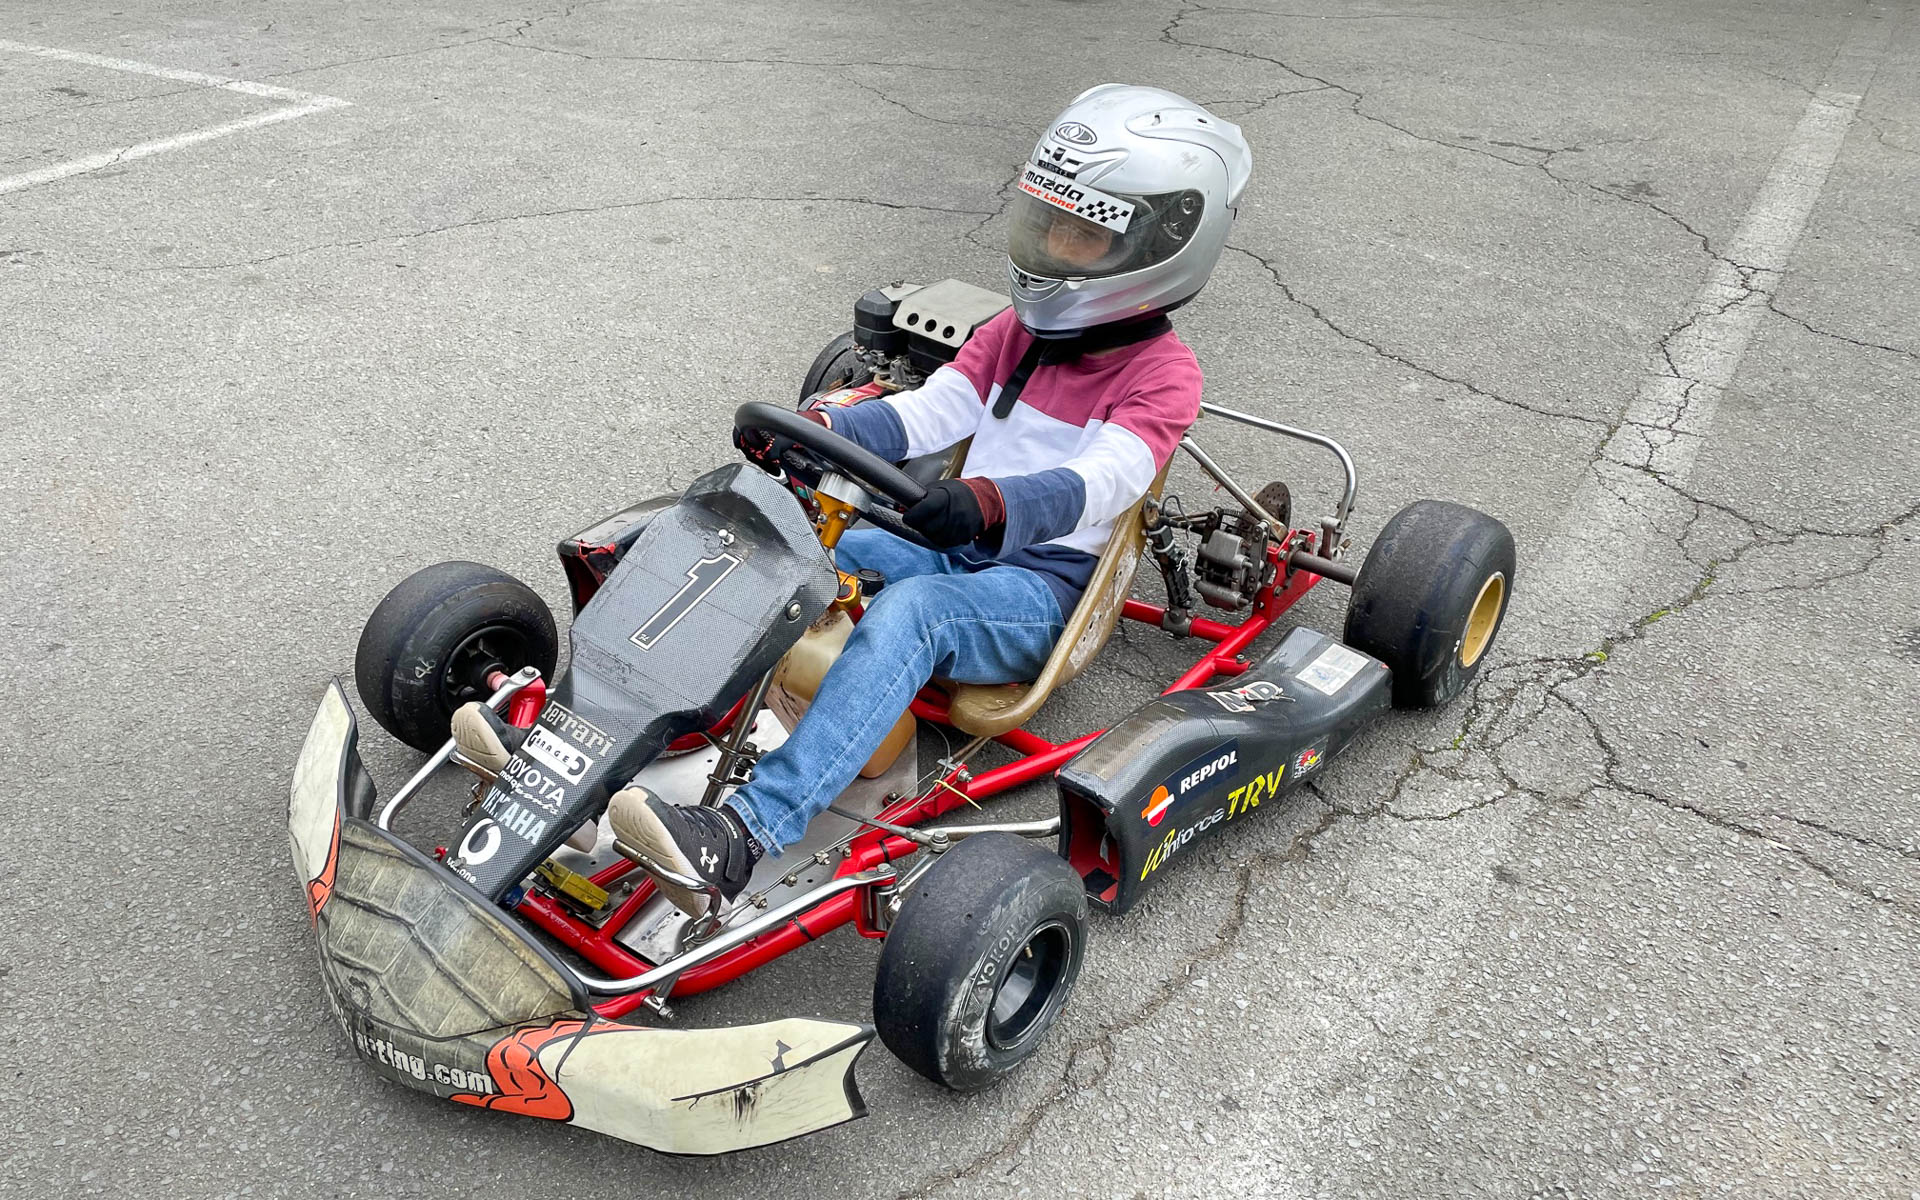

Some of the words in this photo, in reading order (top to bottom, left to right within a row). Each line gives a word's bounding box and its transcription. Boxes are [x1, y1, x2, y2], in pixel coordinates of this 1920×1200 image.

[628, 551, 744, 652] 1
[541, 700, 617, 757] Ferrari
[505, 753, 566, 808] TOYOTA
[1180, 750, 1238, 795] REPSOL
[356, 1029, 494, 1095] arting.com
